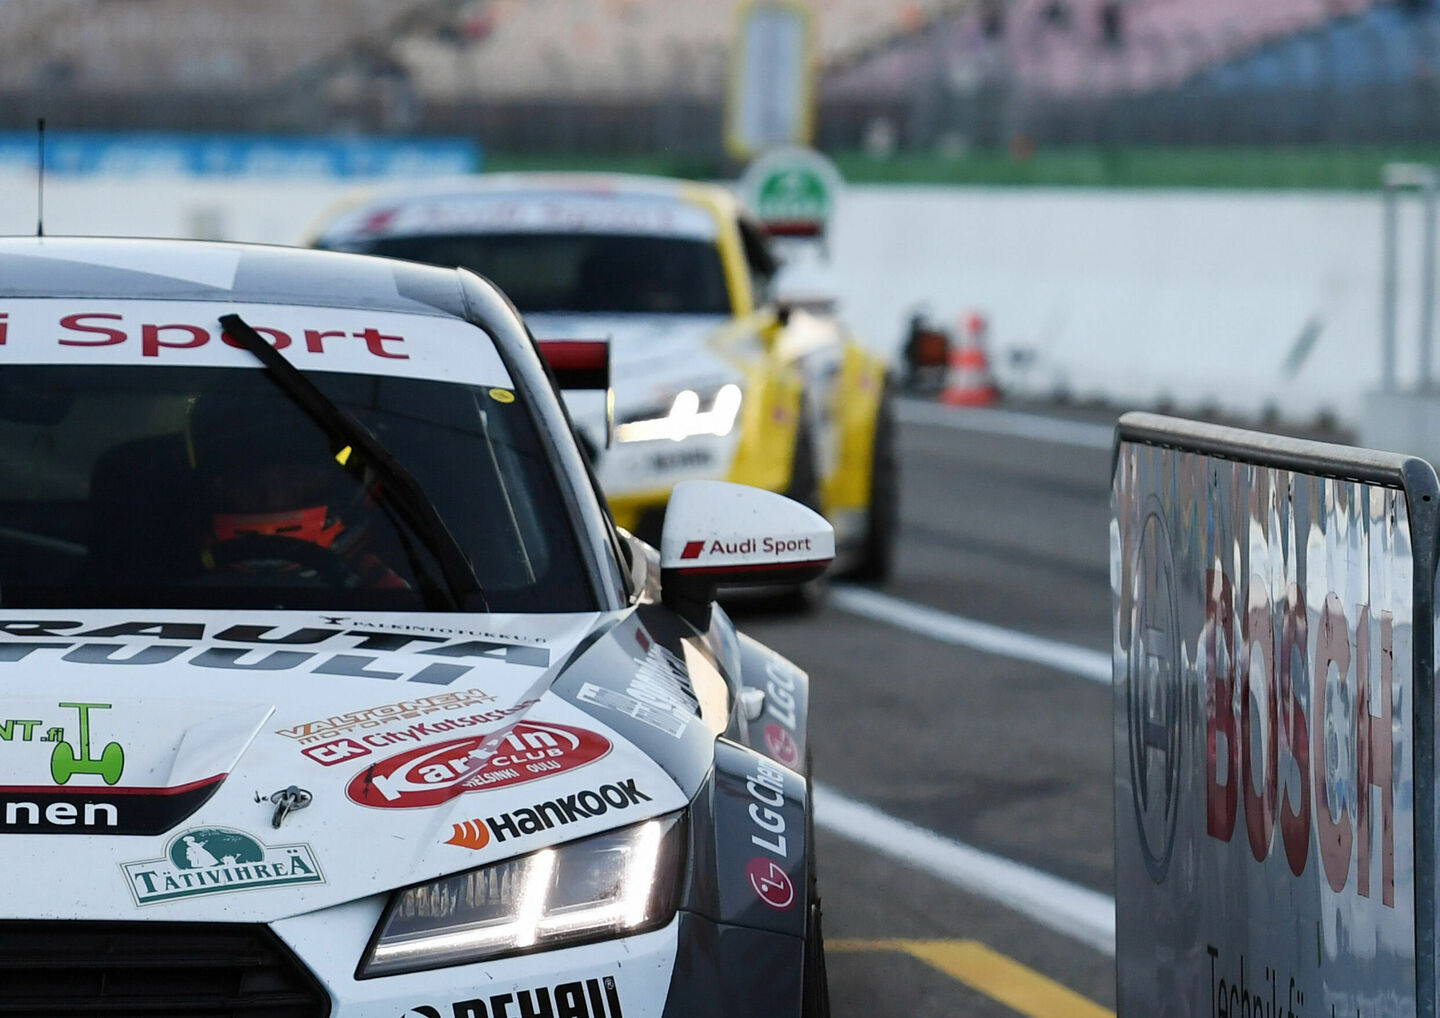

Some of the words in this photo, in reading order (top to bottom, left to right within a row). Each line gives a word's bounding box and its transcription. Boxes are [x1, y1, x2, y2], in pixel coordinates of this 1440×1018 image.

[58, 312, 411, 361] Sport
[710, 539, 757, 555] Audi
[763, 537, 811, 555] Sport
[275, 688, 489, 739] VALTONEN
[296, 695, 499, 745] MOTORSPORT
[491, 748, 565, 767] CLUB
[1206, 568, 1395, 909] BOSCH
[463, 767, 520, 788] HELSINKI
[527, 760, 562, 773] OULU
[134, 849, 315, 894] TÄTIVIHREÄ
